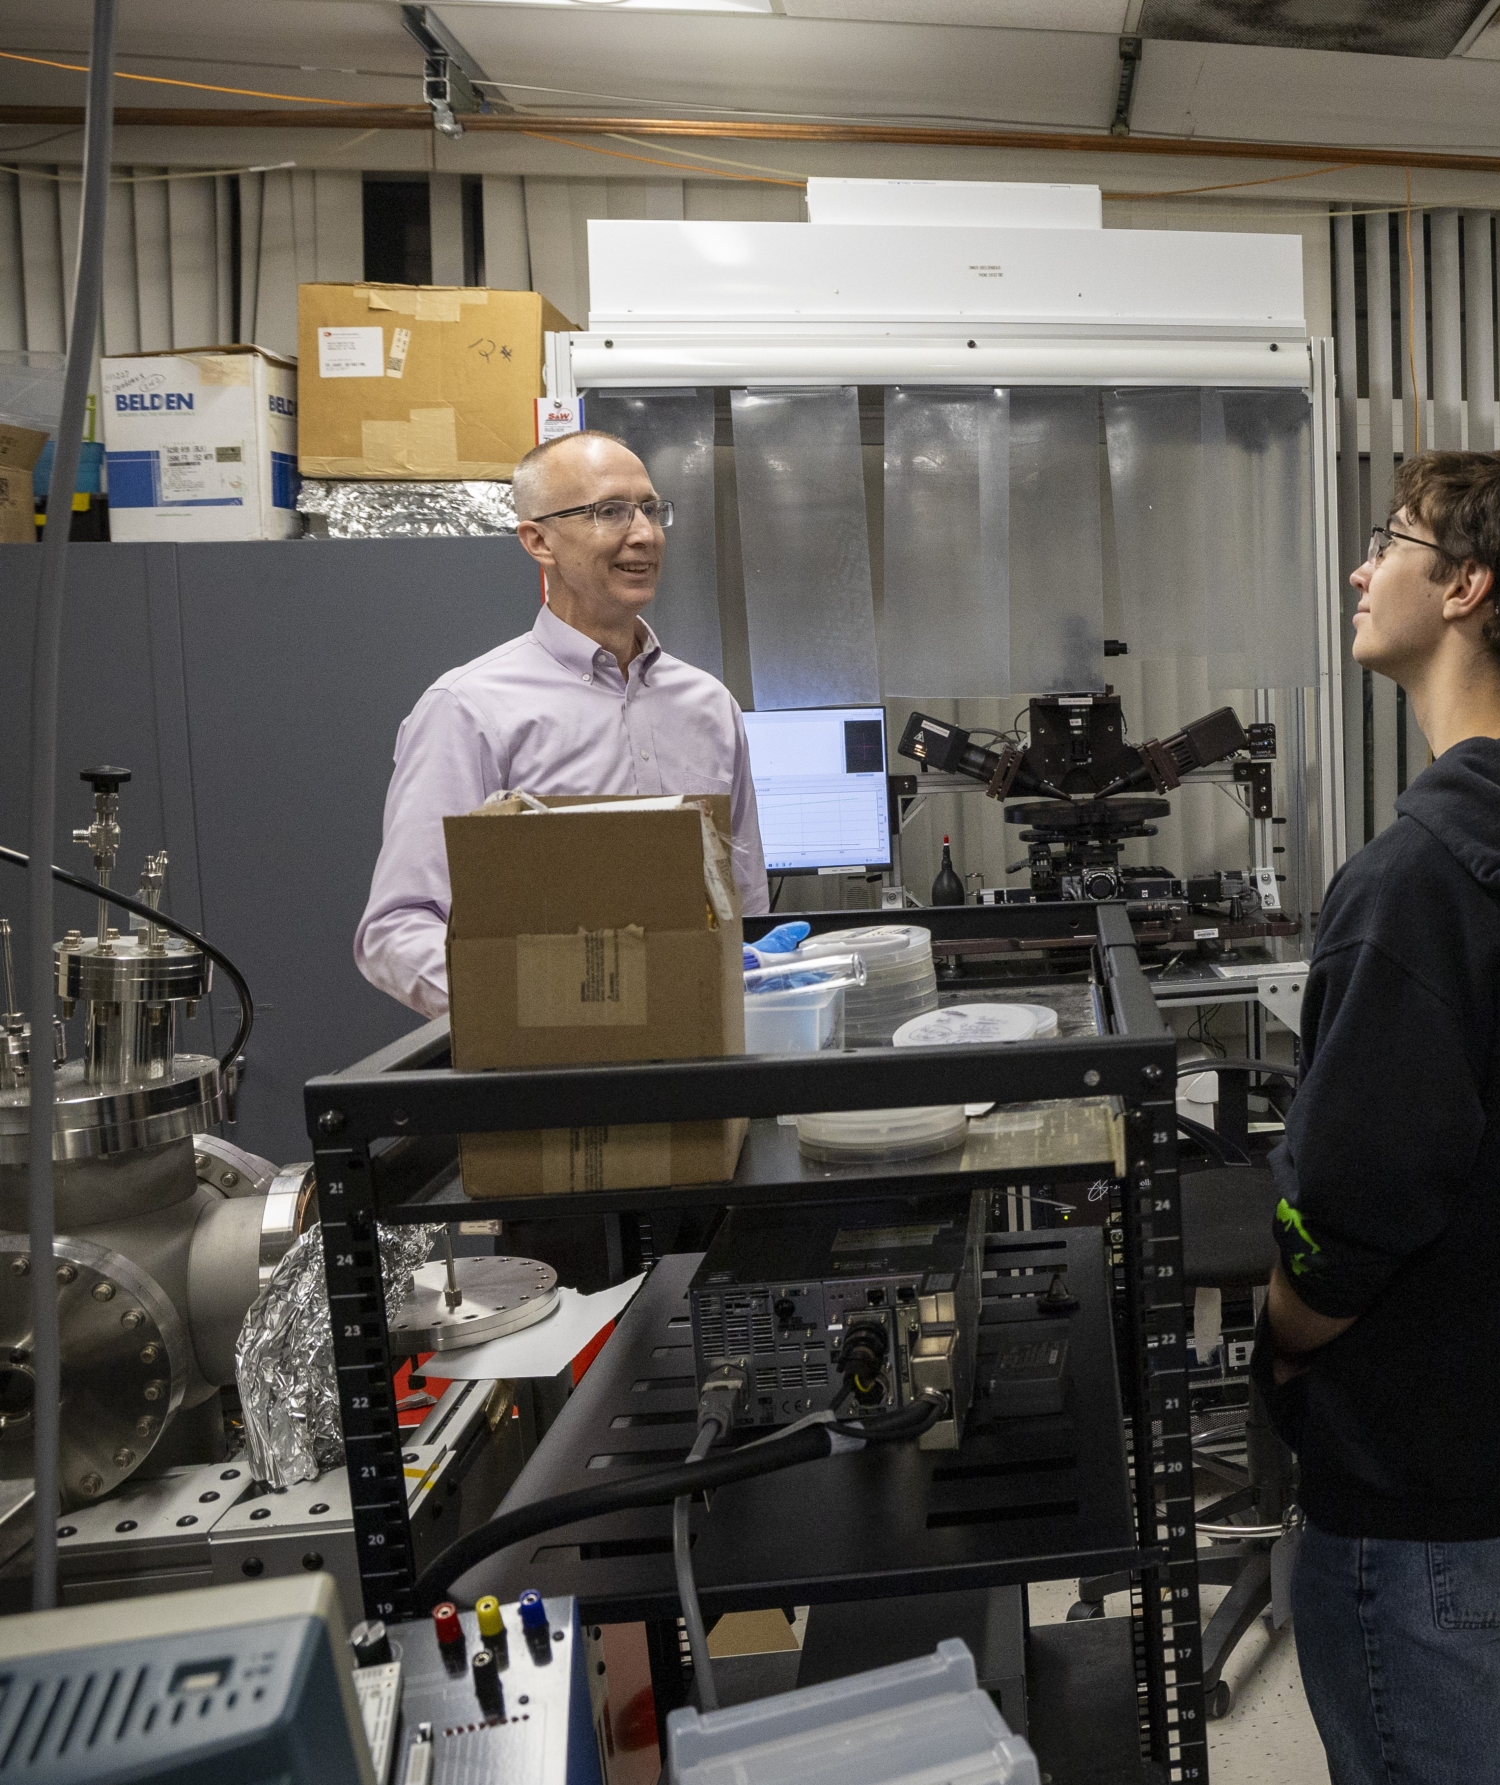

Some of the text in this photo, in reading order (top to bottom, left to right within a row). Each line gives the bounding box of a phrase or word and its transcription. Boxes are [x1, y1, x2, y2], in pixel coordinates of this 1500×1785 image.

[116, 393, 194, 411] BELDEN
[1153, 1131, 1168, 1144] 25
[1156, 1199, 1171, 1211] 24
[336, 1254, 354, 1266] 24
[1158, 1265, 1174, 1278] 23
[344, 1324, 361, 1337] 23
[1161, 1333, 1177, 1345] 22
[352, 1396, 369, 1409] 22
[1165, 1398, 1179, 1410] 21
[361, 1466, 377, 1478] 21
[1167, 1461, 1183, 1473] 20
[1171, 1526, 1186, 1537] 19
[368, 1534, 385, 1546] 20
[1174, 1587, 1189, 1599] 18
[377, 1602, 393, 1614] 19
[1178, 1648, 1192, 1659] 17
[1181, 1709, 1196, 1720] 16
[1185, 1768, 1199, 1779] 15
